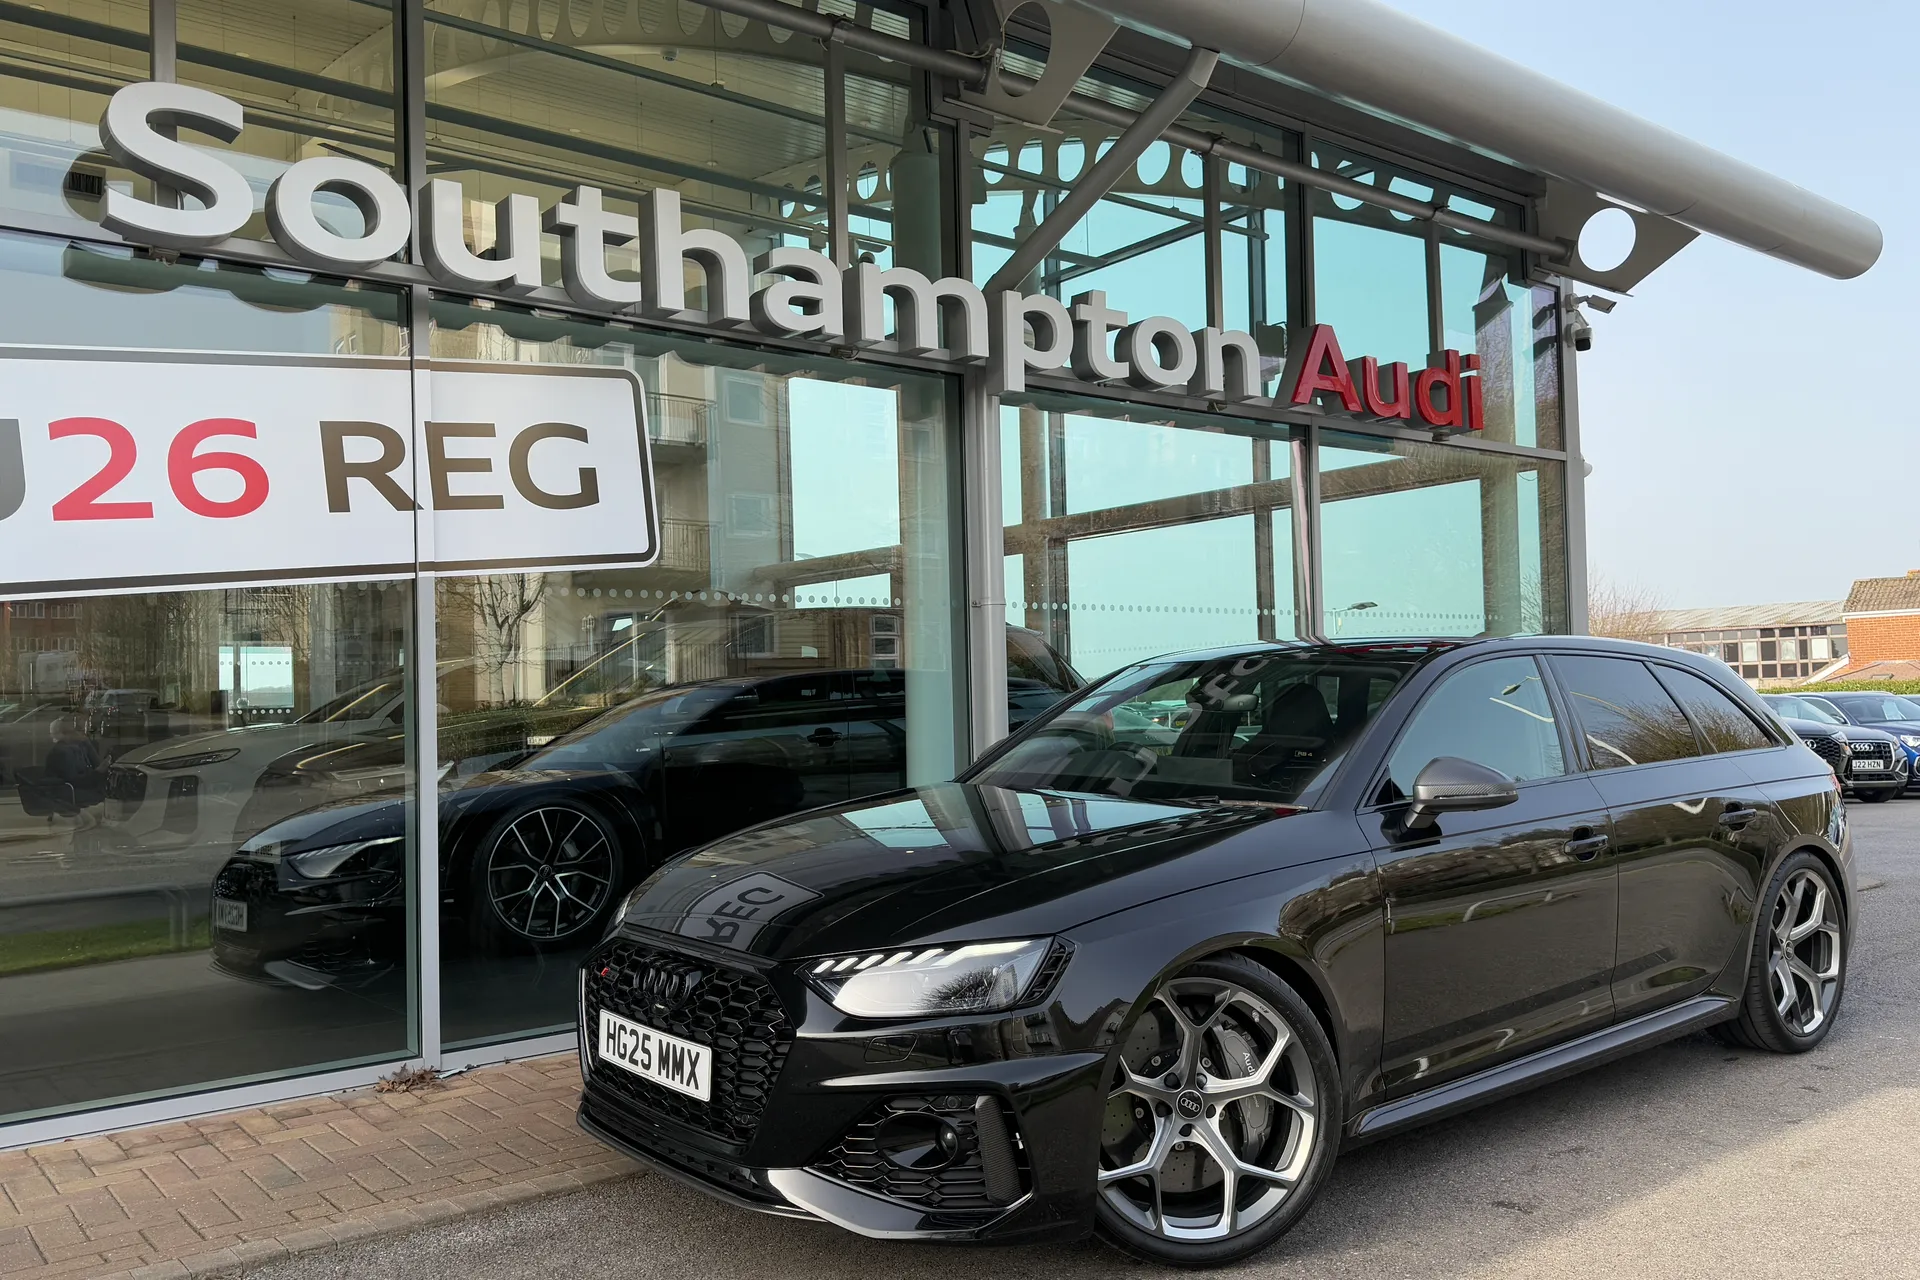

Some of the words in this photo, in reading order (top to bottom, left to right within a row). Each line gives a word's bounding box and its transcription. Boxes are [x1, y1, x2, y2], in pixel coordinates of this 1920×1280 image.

[100, 81, 1261, 395] Southampton
[1290, 323, 1484, 430] Audi
[0, 417, 269, 521] 26
[319, 420, 600, 513] REG
[606, 1018, 652, 1071] HG25
[657, 1038, 701, 1091] MMX
[1242, 1052, 1256, 1076] Audi
